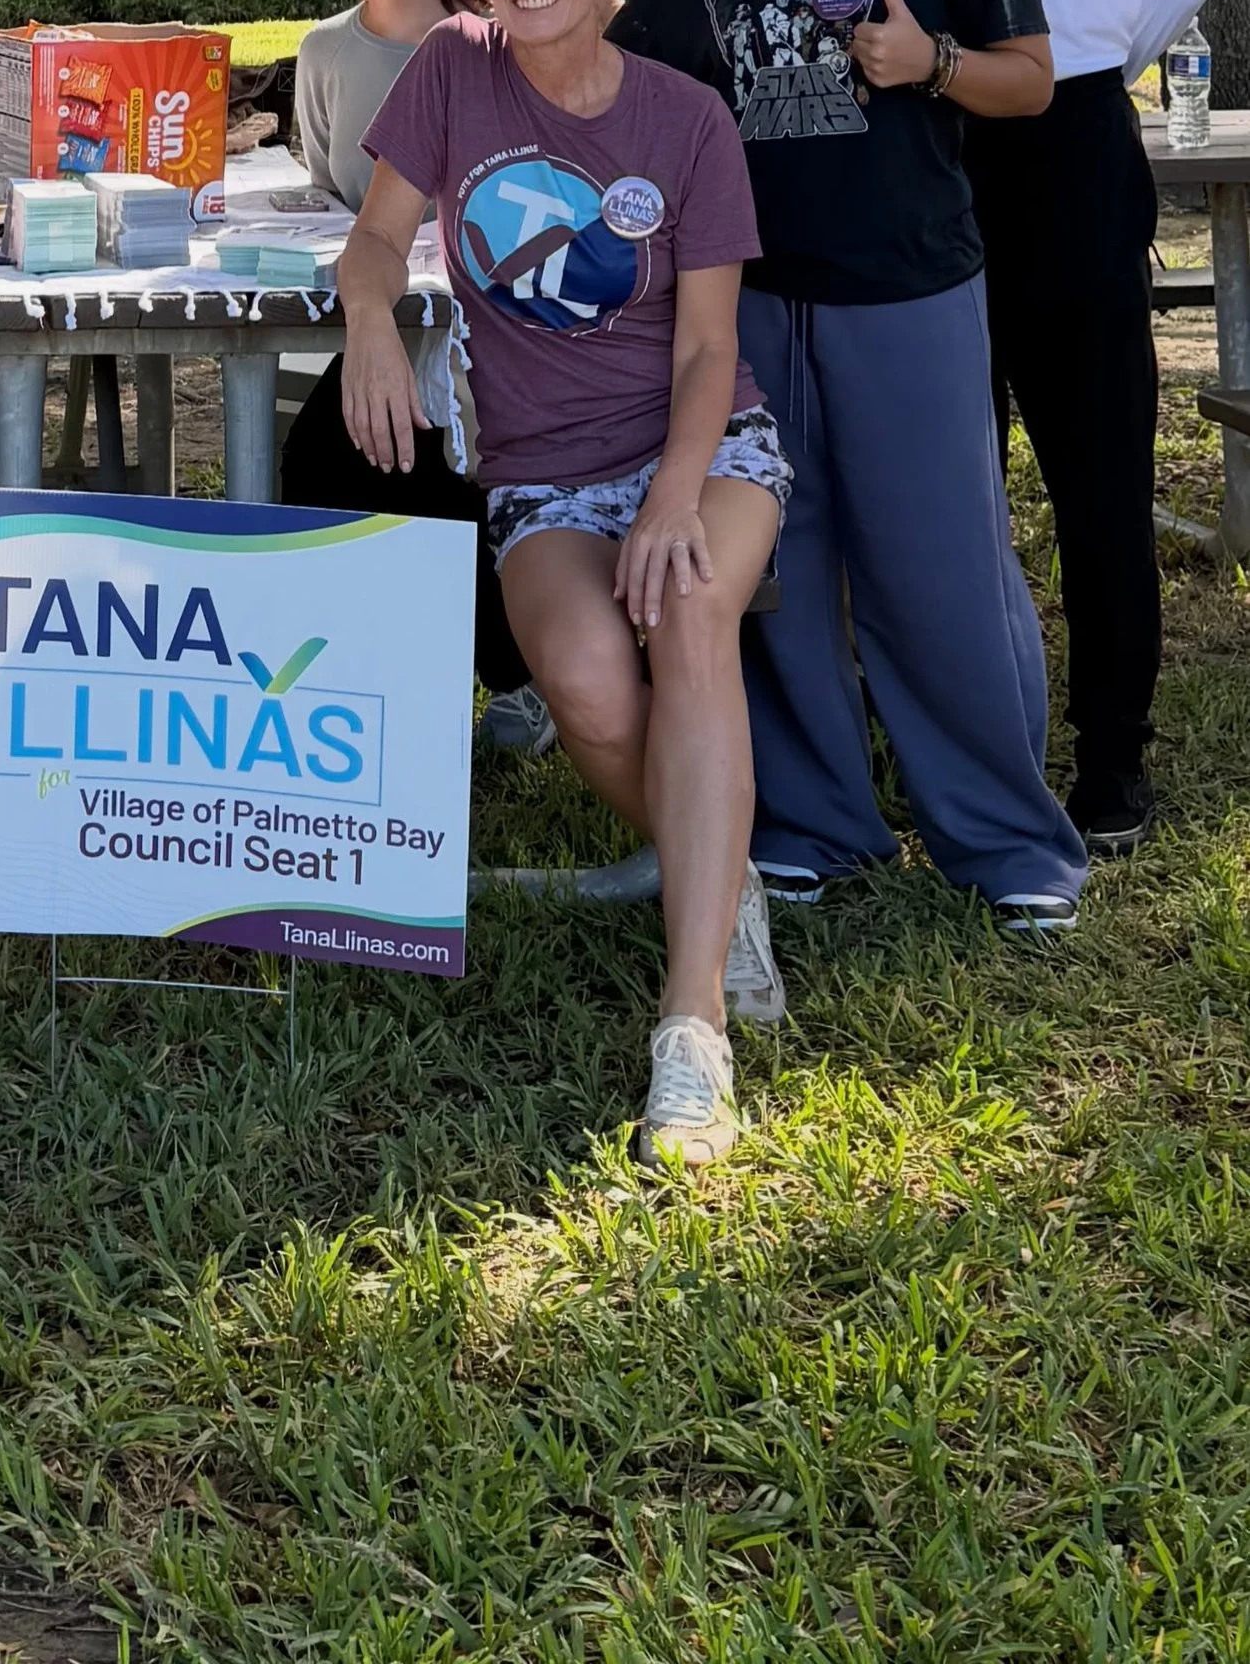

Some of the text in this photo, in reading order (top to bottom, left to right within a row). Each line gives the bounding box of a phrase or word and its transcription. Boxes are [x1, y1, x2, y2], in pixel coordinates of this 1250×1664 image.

[754, 65, 843, 99] STAR
[130, 93, 141, 119] 100%
[740, 93, 867, 140] WARS
[130, 120, 140, 154] WHOLE
[147, 115, 161, 168] CHIPS
[155, 89, 190, 160] Sun
[469, 164, 486, 180] FOR
[484, 150, 509, 168] TANA
[209, 196, 225, 214] 18
[609, 199, 657, 224] LLINAS
[616, 188, 653, 210] TANA
[10, 682, 364, 783] LLINAS
[37, 768, 71, 799] for
[79, 789, 446, 859] Village of Palmetto Bay
[79, 821, 363, 885] Council Seat 1
[280, 920, 449, 964] TanaLlinas.com
